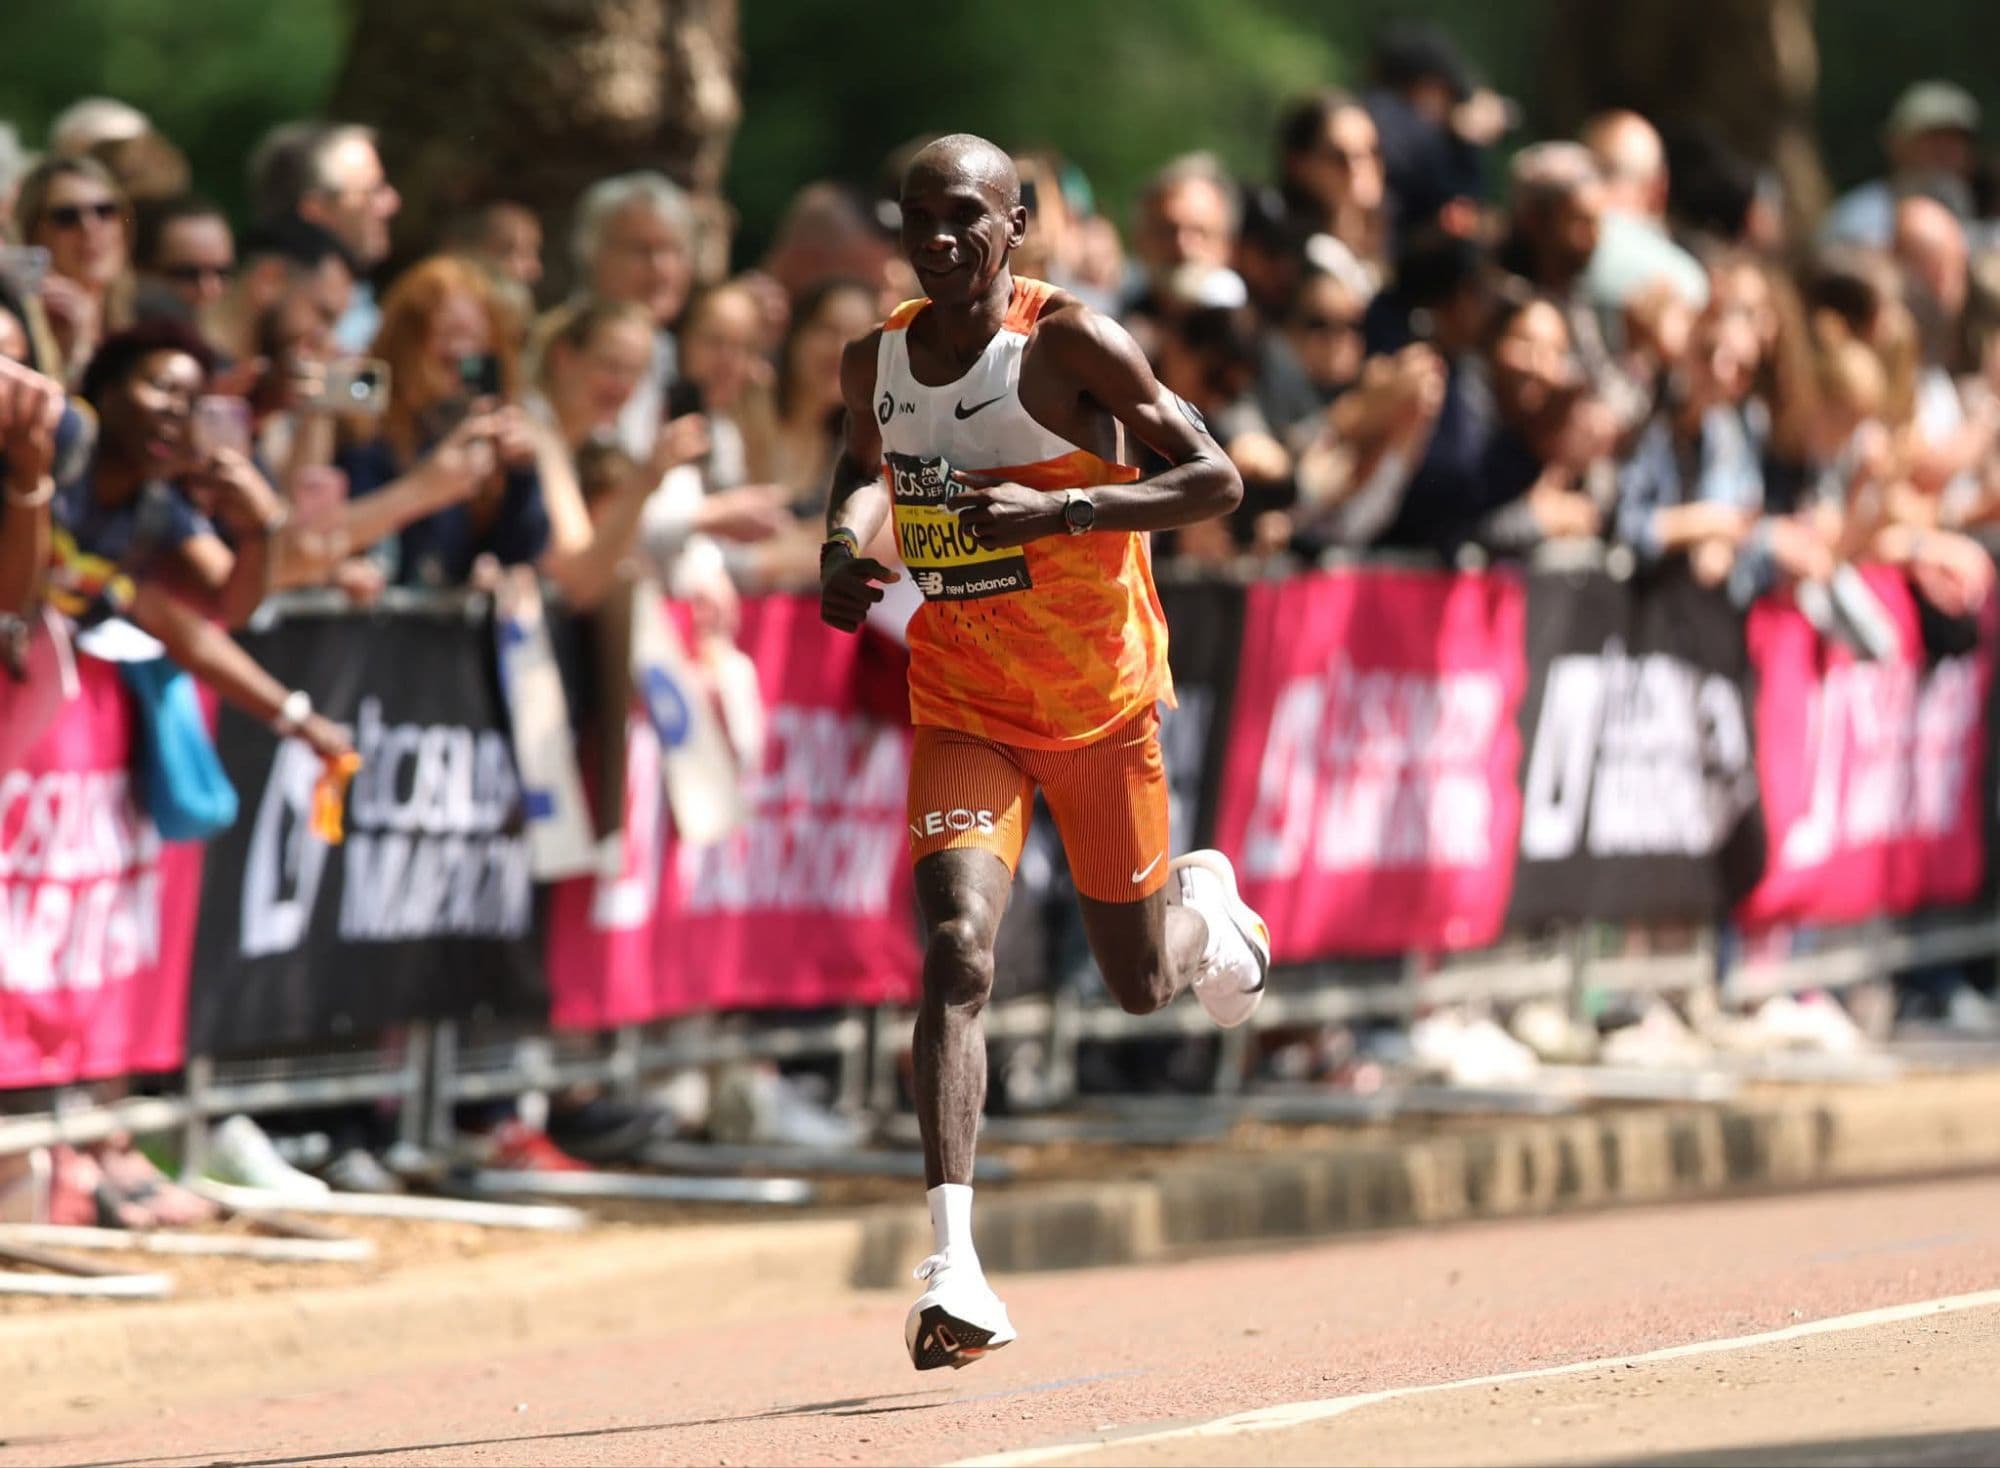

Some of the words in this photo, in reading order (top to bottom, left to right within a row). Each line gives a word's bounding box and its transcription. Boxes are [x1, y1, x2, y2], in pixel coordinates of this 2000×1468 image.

[901, 521, 993, 559] KIPCHO
[945, 585, 966, 595] new
[965, 576, 1017, 593] balance
